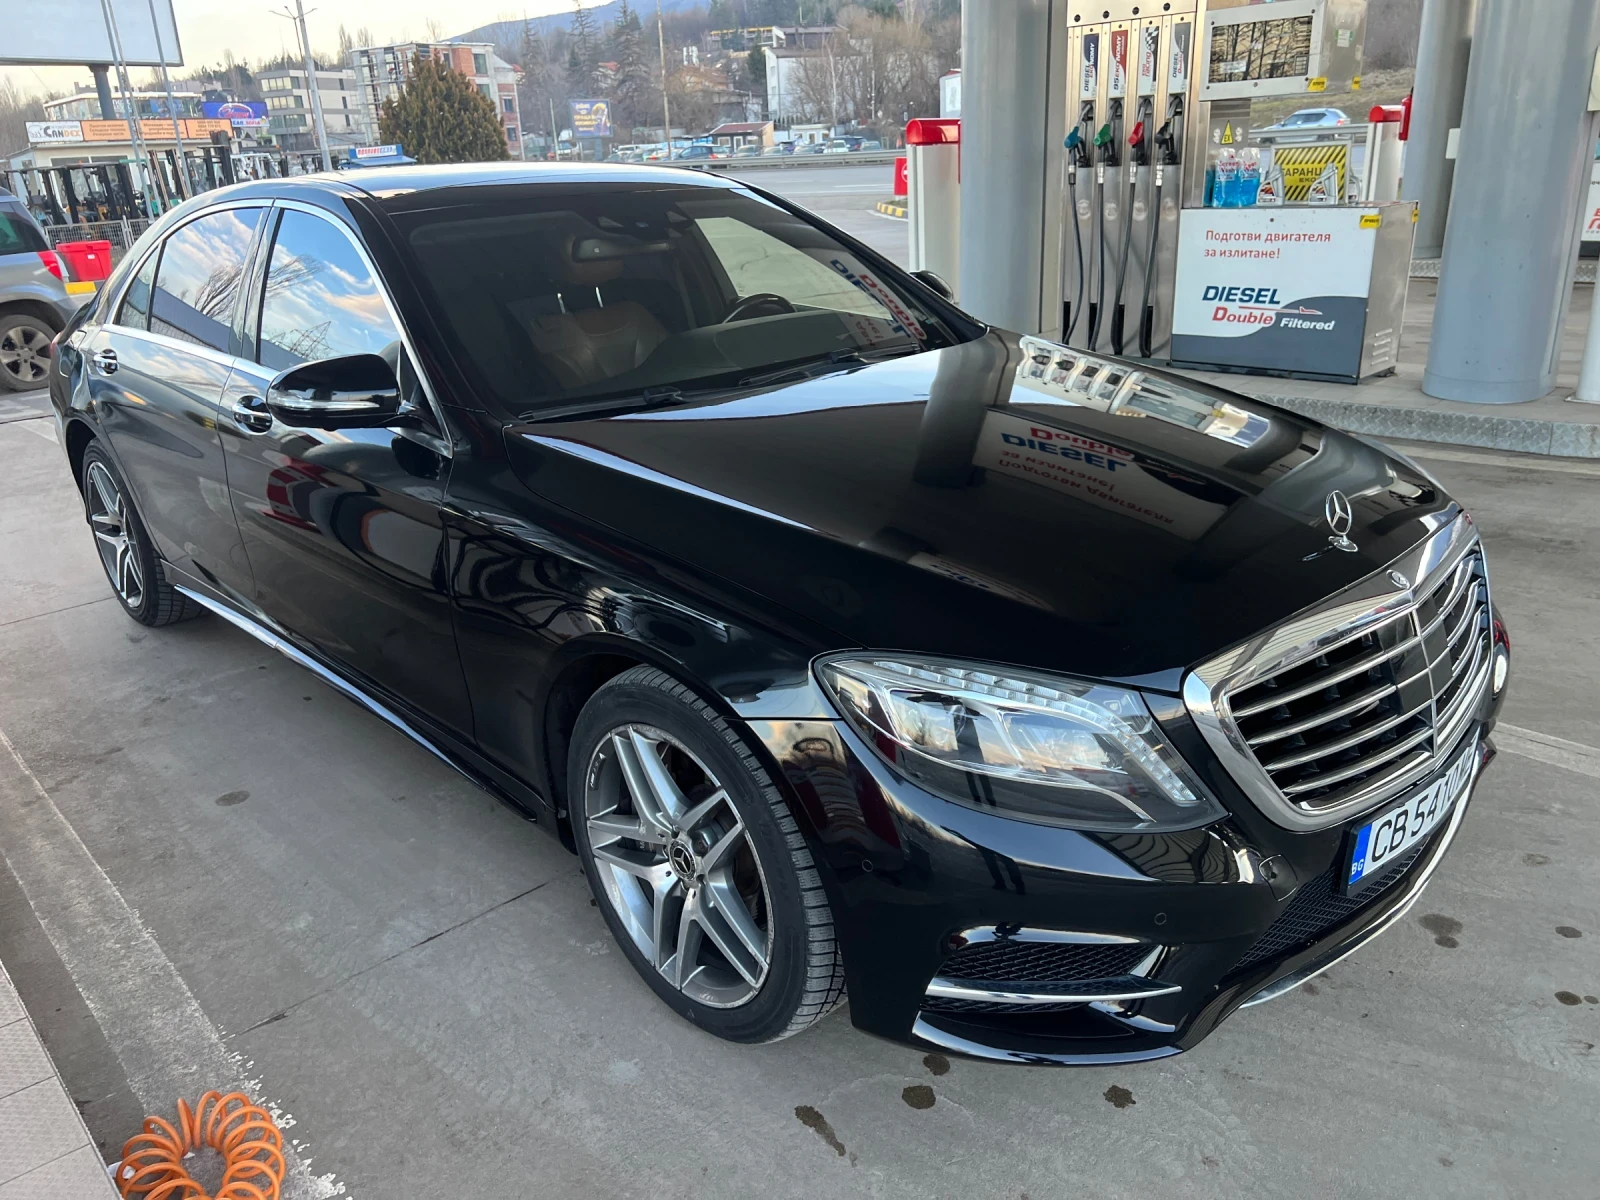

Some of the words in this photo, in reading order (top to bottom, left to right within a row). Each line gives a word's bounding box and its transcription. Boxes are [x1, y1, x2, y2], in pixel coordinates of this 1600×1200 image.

[43, 126, 80, 138] CANDEX
[1223, 134, 1231, 142] EX
[1206, 230, 1261, 243] Подготви
[1265, 233, 1331, 243] двигателя
[1204, 249, 1217, 257] за
[1219, 248, 1281, 259] излитане!
[1202, 286, 1281, 305] DIESEL
[1212, 306, 1273, 326] Double
[1280, 318, 1335, 331] Filtered
[1371, 809, 1408, 863] CB
[1351, 858, 1364, 875] BG
